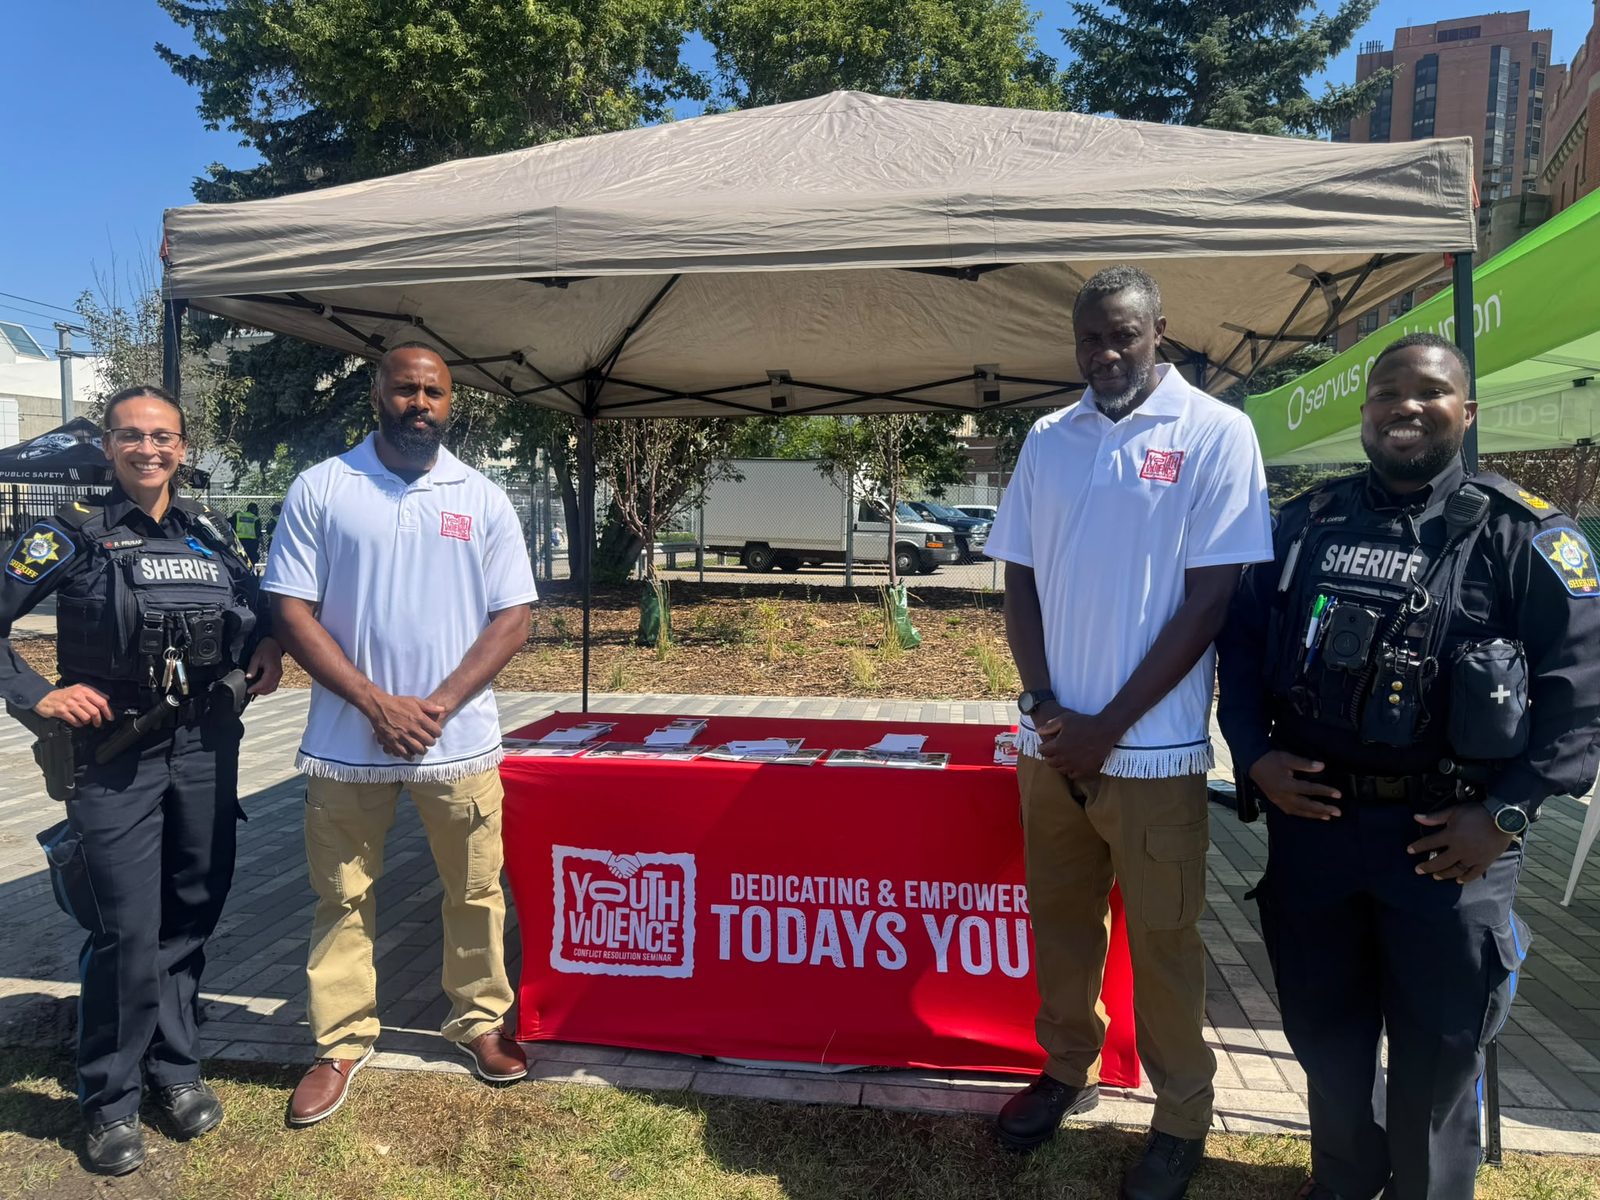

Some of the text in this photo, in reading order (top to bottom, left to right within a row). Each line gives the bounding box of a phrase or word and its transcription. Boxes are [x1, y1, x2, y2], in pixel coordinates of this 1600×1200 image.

[1305, 364, 1360, 414] servus
[32, 471, 65, 479] SAFETY
[9, 559, 39, 579] SHERIFF
[141, 558, 219, 582] SHERIFF
[1321, 544, 1422, 583] SHERIFF
[569, 871, 680, 921] YOUTH
[730, 873, 1030, 914] DEDICATING & EMPOWER
[568, 902, 678, 953] VIOLENCE
[710, 904, 1032, 978] TODAYS YOU
[573, 948, 672, 962] CONFLICT RESOLUTION SEMINAR
